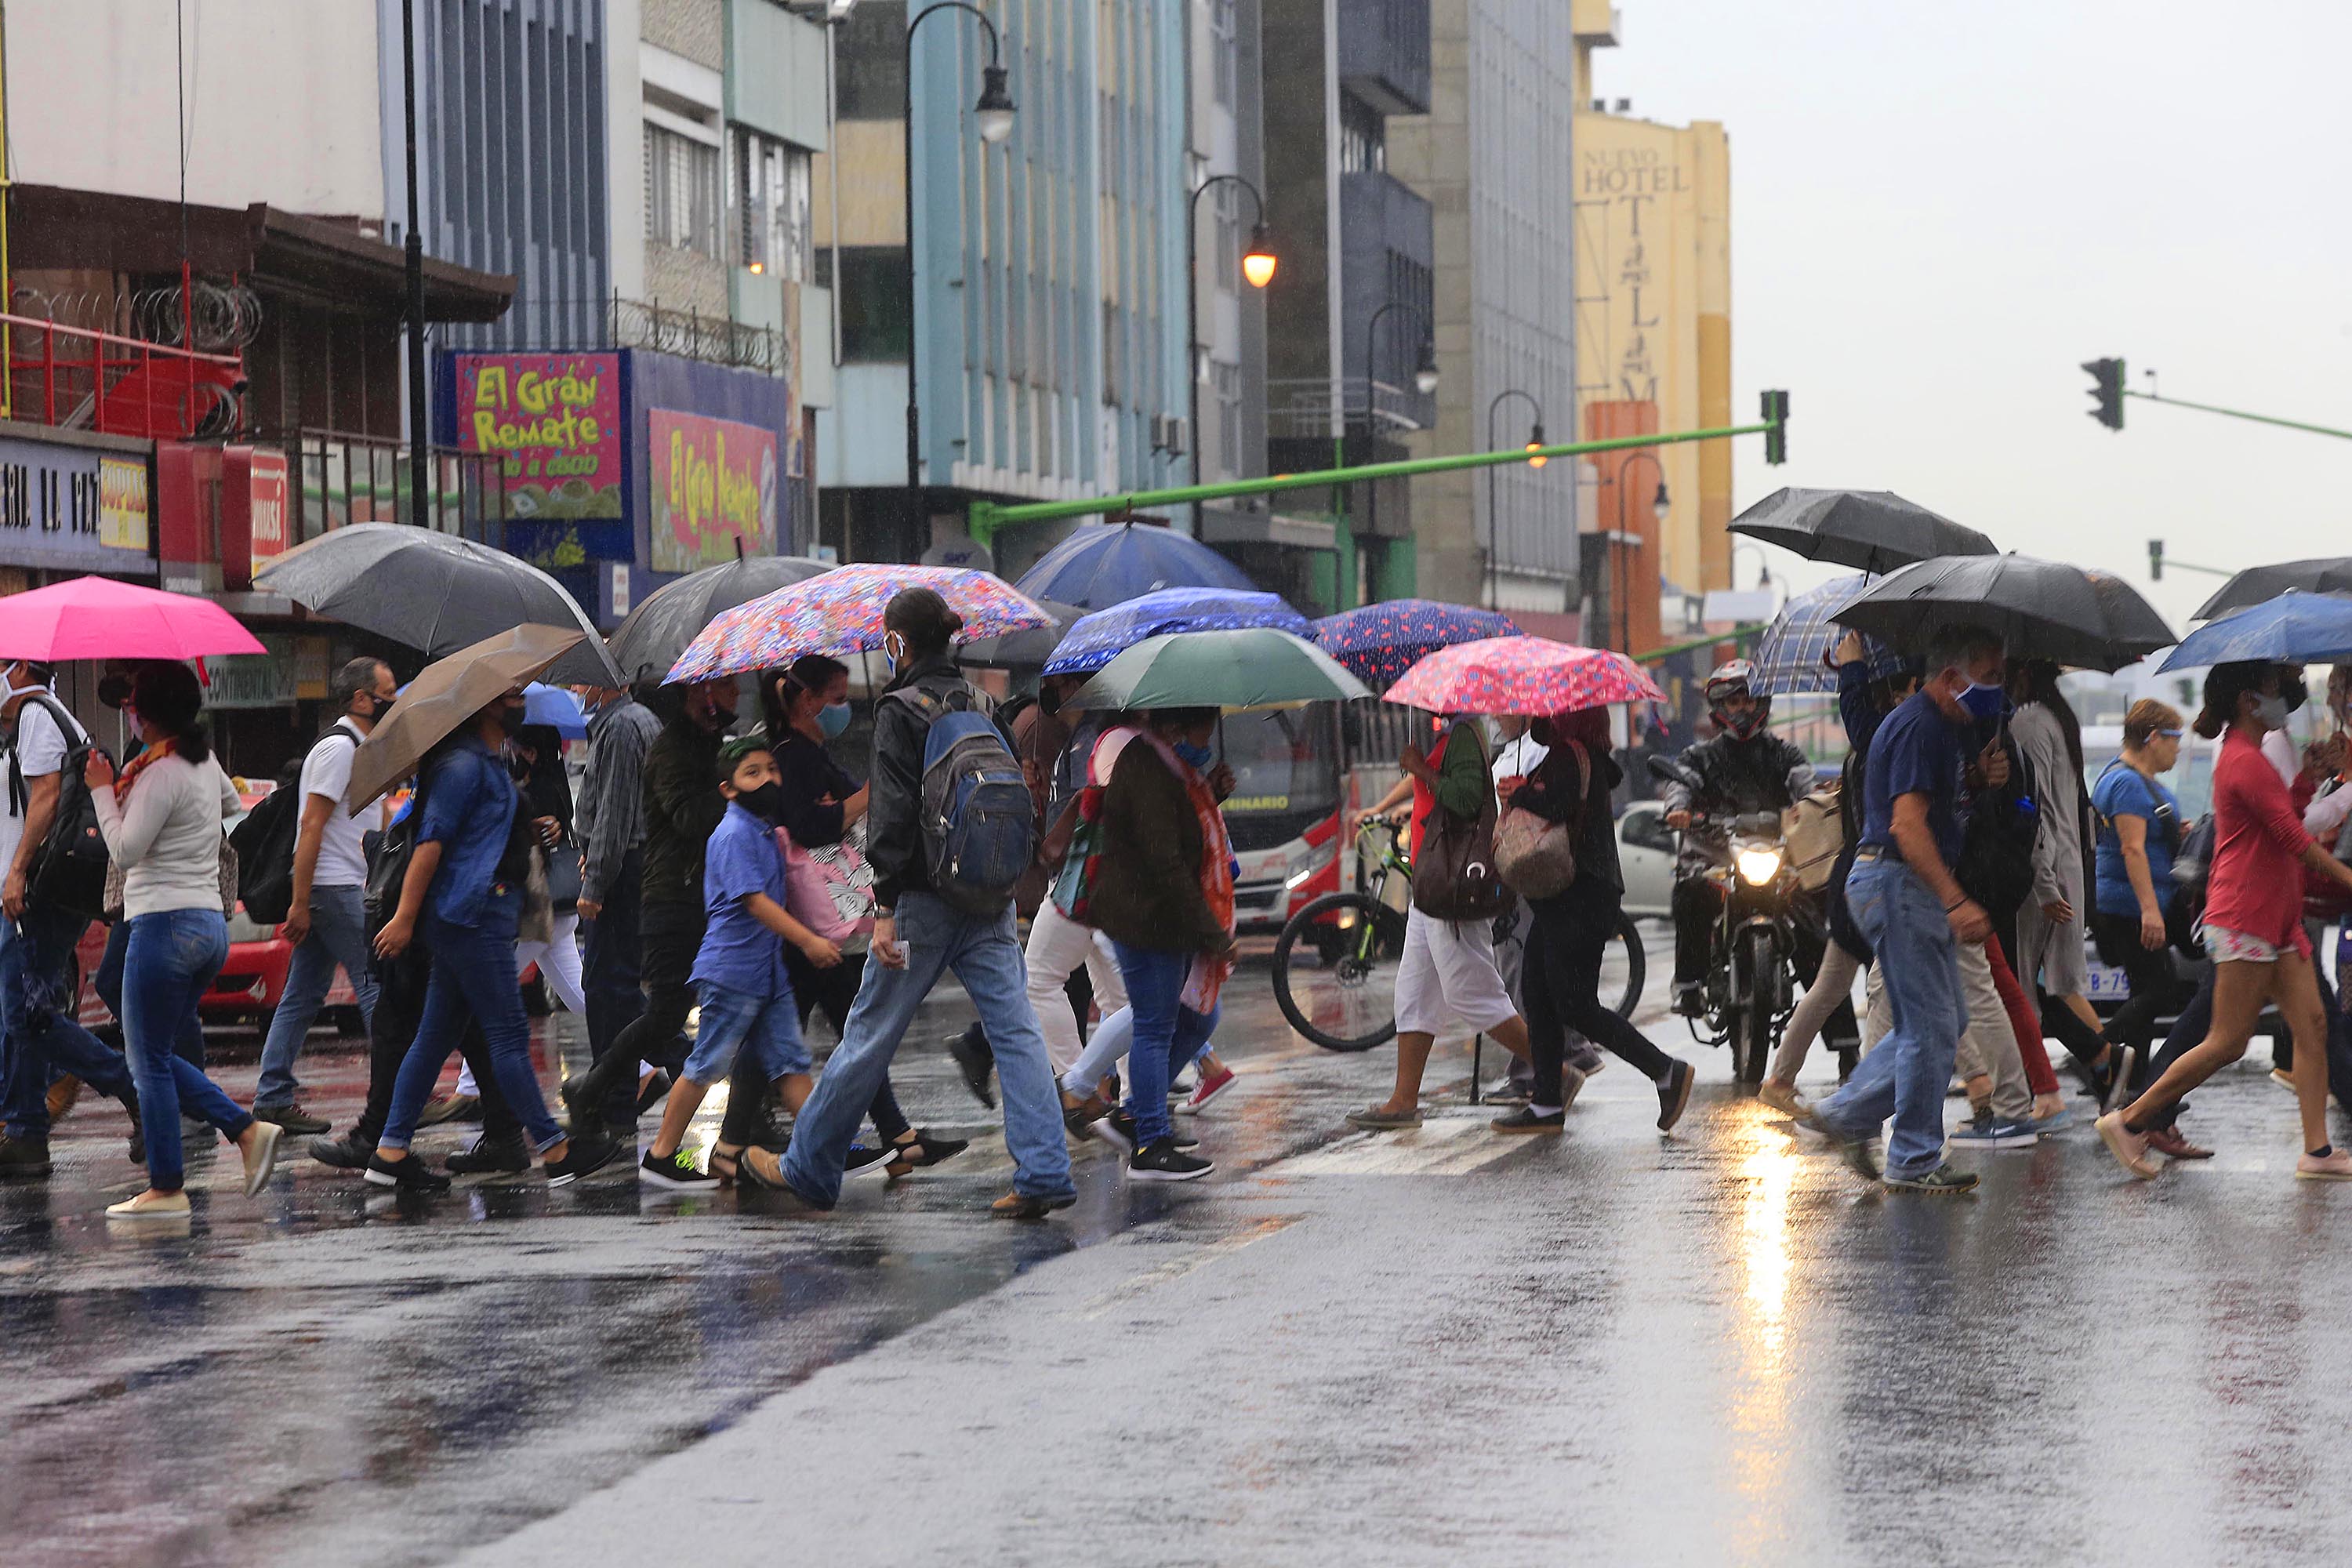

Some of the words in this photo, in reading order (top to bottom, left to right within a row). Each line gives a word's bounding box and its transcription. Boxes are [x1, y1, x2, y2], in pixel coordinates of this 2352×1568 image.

[1584, 147, 1660, 167] NUEVO
[1584, 166, 1690, 194] HOTEL
[474, 365, 508, 411] El
[0, 463, 31, 528] RIA
[41, 467, 60, 533] LA
[102, 463, 147, 514] COPIAS
[671, 427, 684, 521] El
